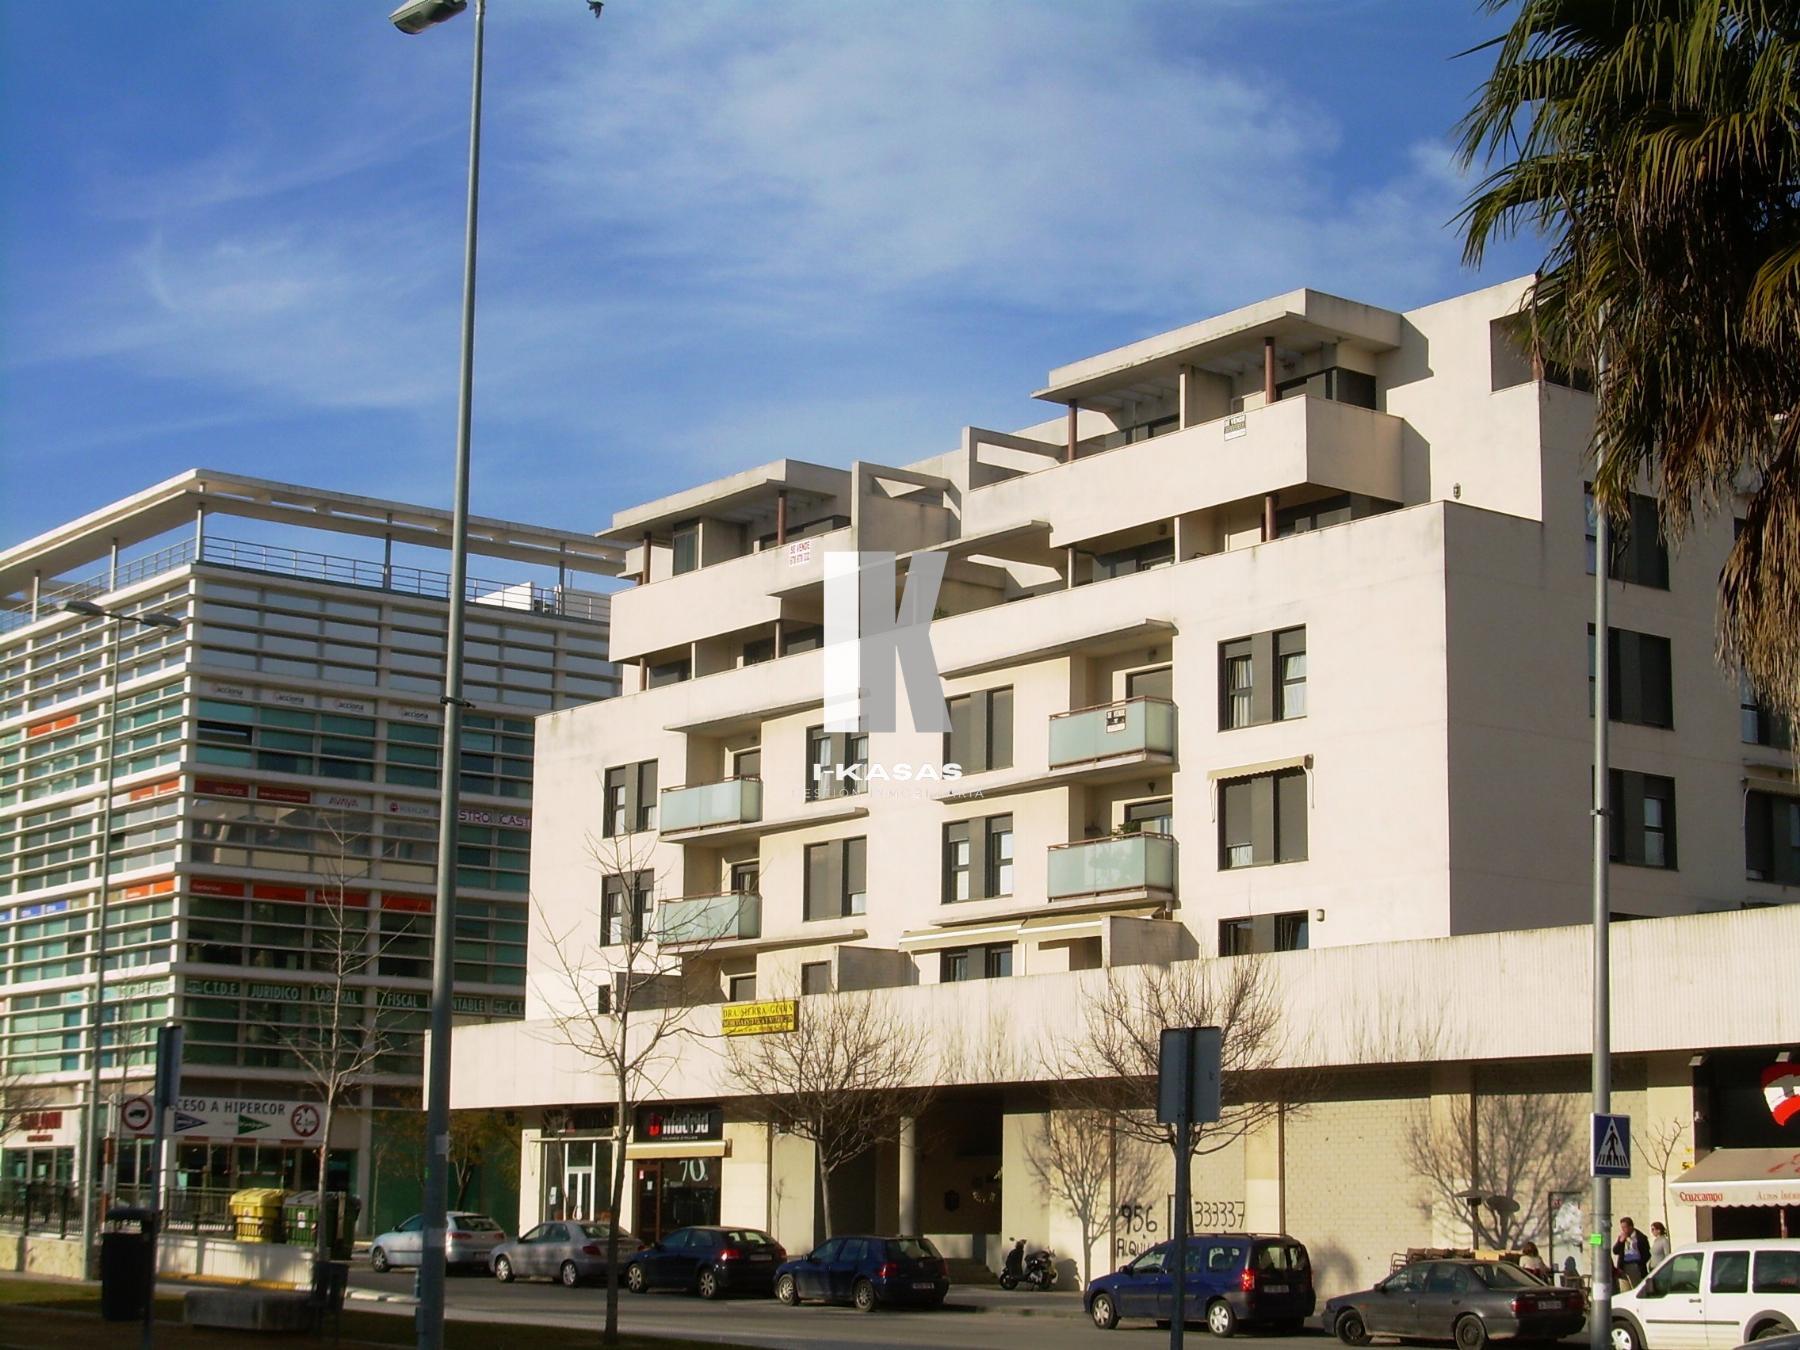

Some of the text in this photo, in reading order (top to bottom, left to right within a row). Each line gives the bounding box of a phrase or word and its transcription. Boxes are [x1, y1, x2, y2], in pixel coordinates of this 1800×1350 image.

[314, 988, 357, 1003] LABRAL
[387, 993, 417, 1007] FISCAL
[211, 1101, 219, 1112] A
[224, 1102, 285, 1115] HIPERCOR
[1680, 1192, 1723, 1202] Cruzcampo
[1121, 1204, 1157, 1235] 956
